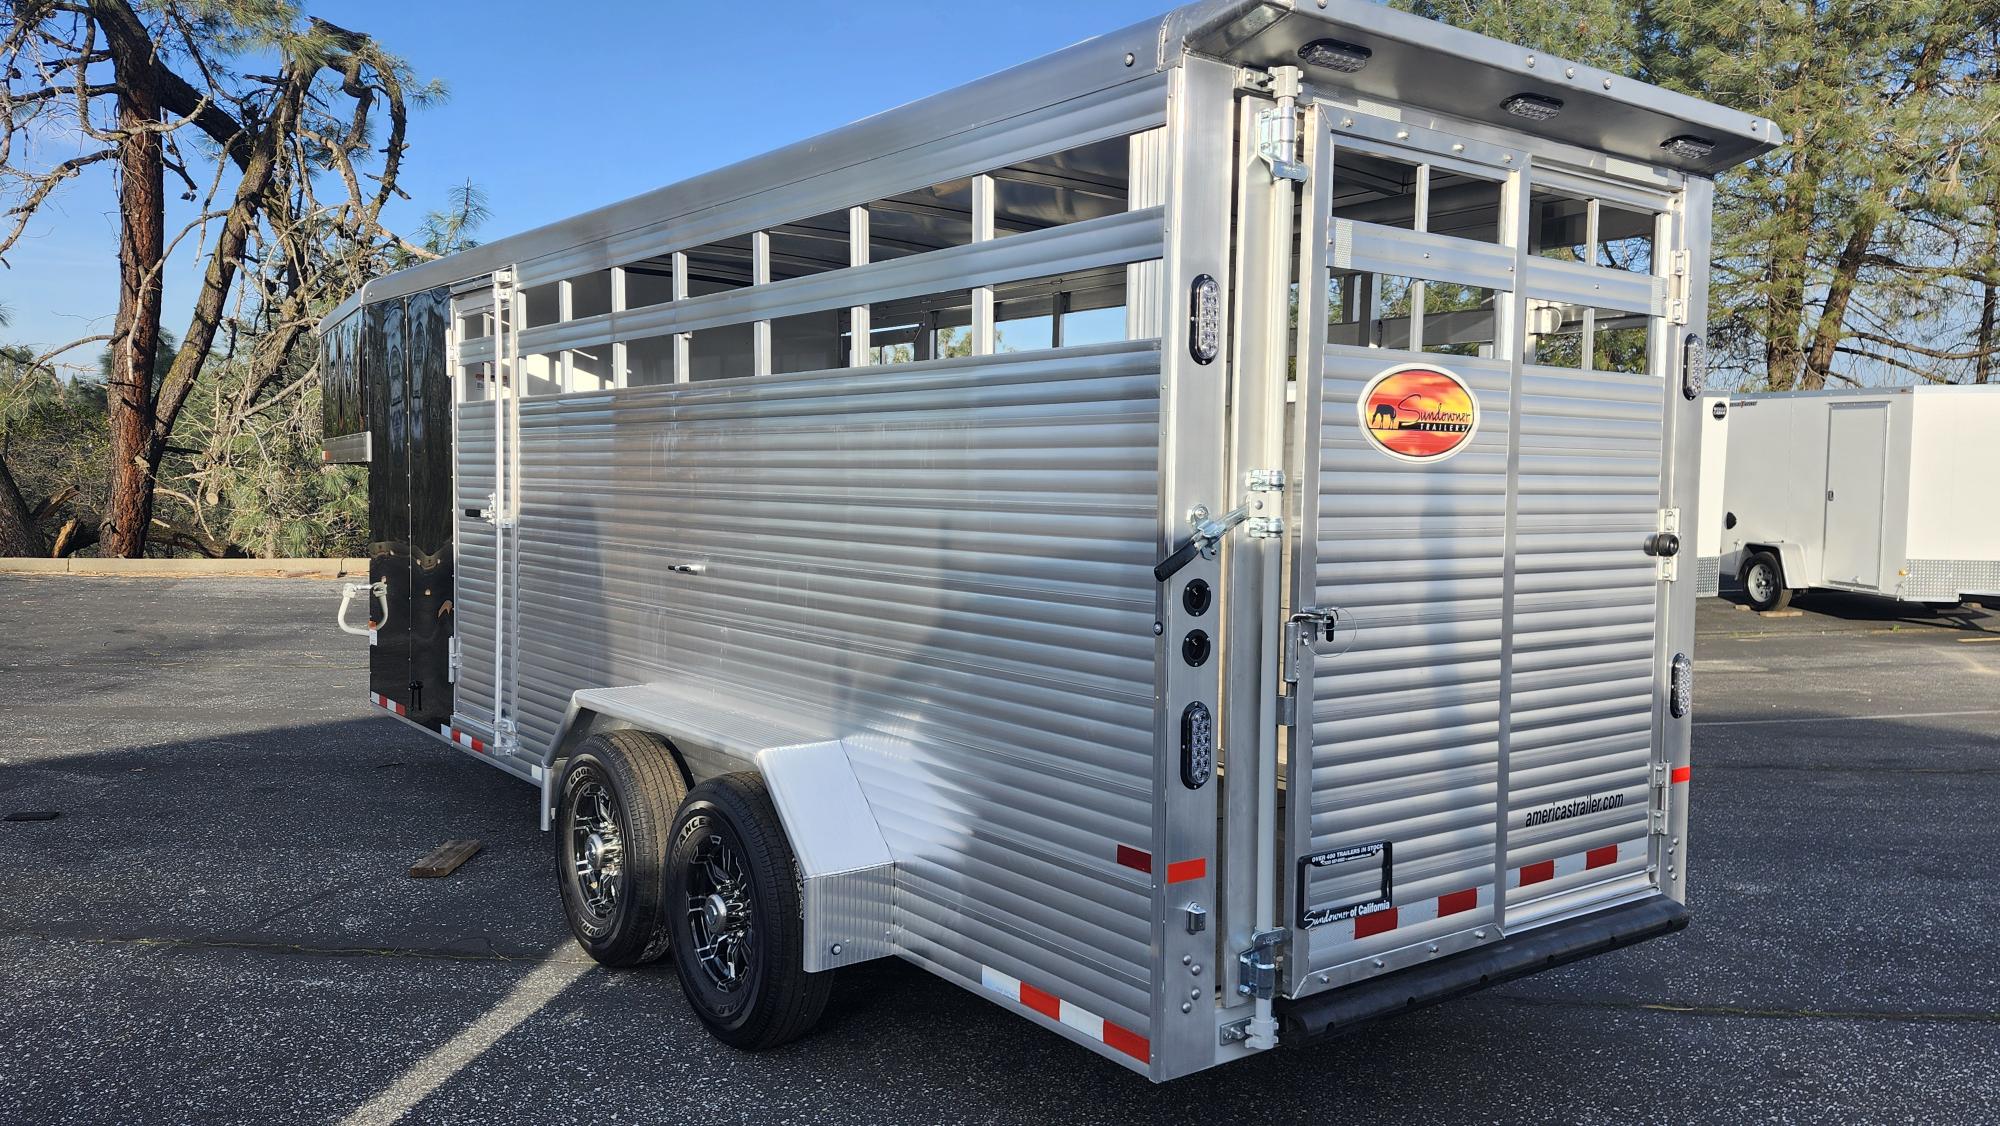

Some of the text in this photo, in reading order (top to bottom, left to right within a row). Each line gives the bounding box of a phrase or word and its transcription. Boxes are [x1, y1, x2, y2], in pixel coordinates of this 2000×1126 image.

[1398, 394, 1471, 424] Sundowner
[1420, 423, 1467, 432] TRAILERS
[1525, 793, 1624, 827] americastrailer.com
[1311, 855, 1326, 863] OVER
[1336, 848, 1361, 857] TRAILERS
[1367, 843, 1384, 851] STOCK
[1303, 900, 1390, 930] Sundowner of California
